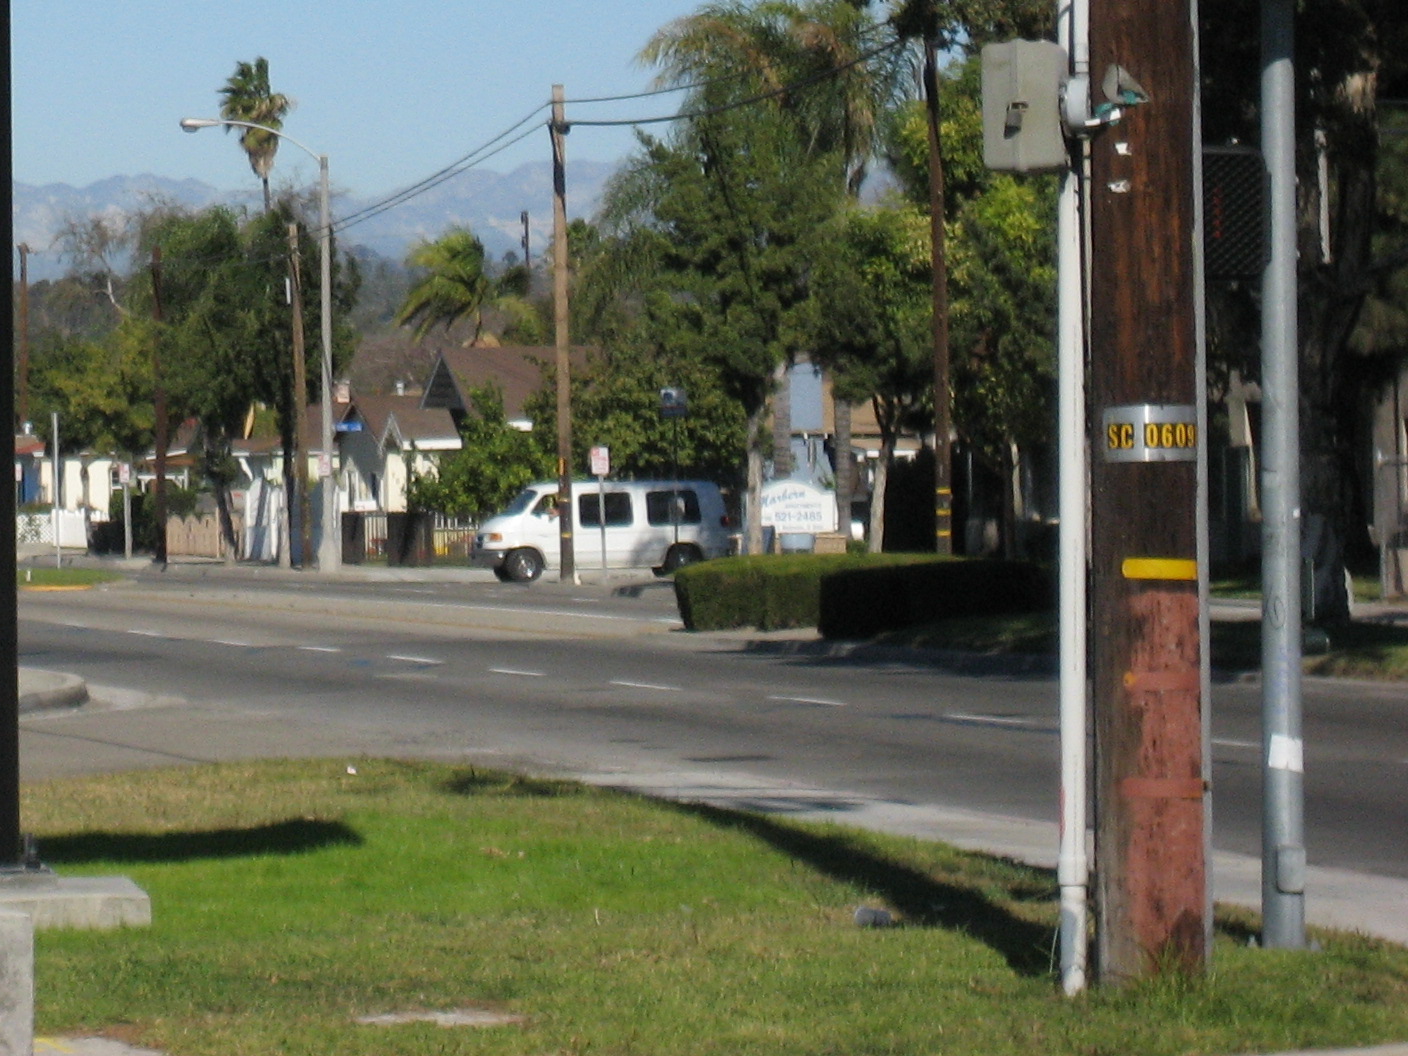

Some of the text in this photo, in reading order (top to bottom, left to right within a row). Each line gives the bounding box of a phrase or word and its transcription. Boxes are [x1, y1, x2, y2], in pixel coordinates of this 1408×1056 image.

[1107, 422, 1196, 449] SC 0609
[774, 511, 823, 522] 521-2485
